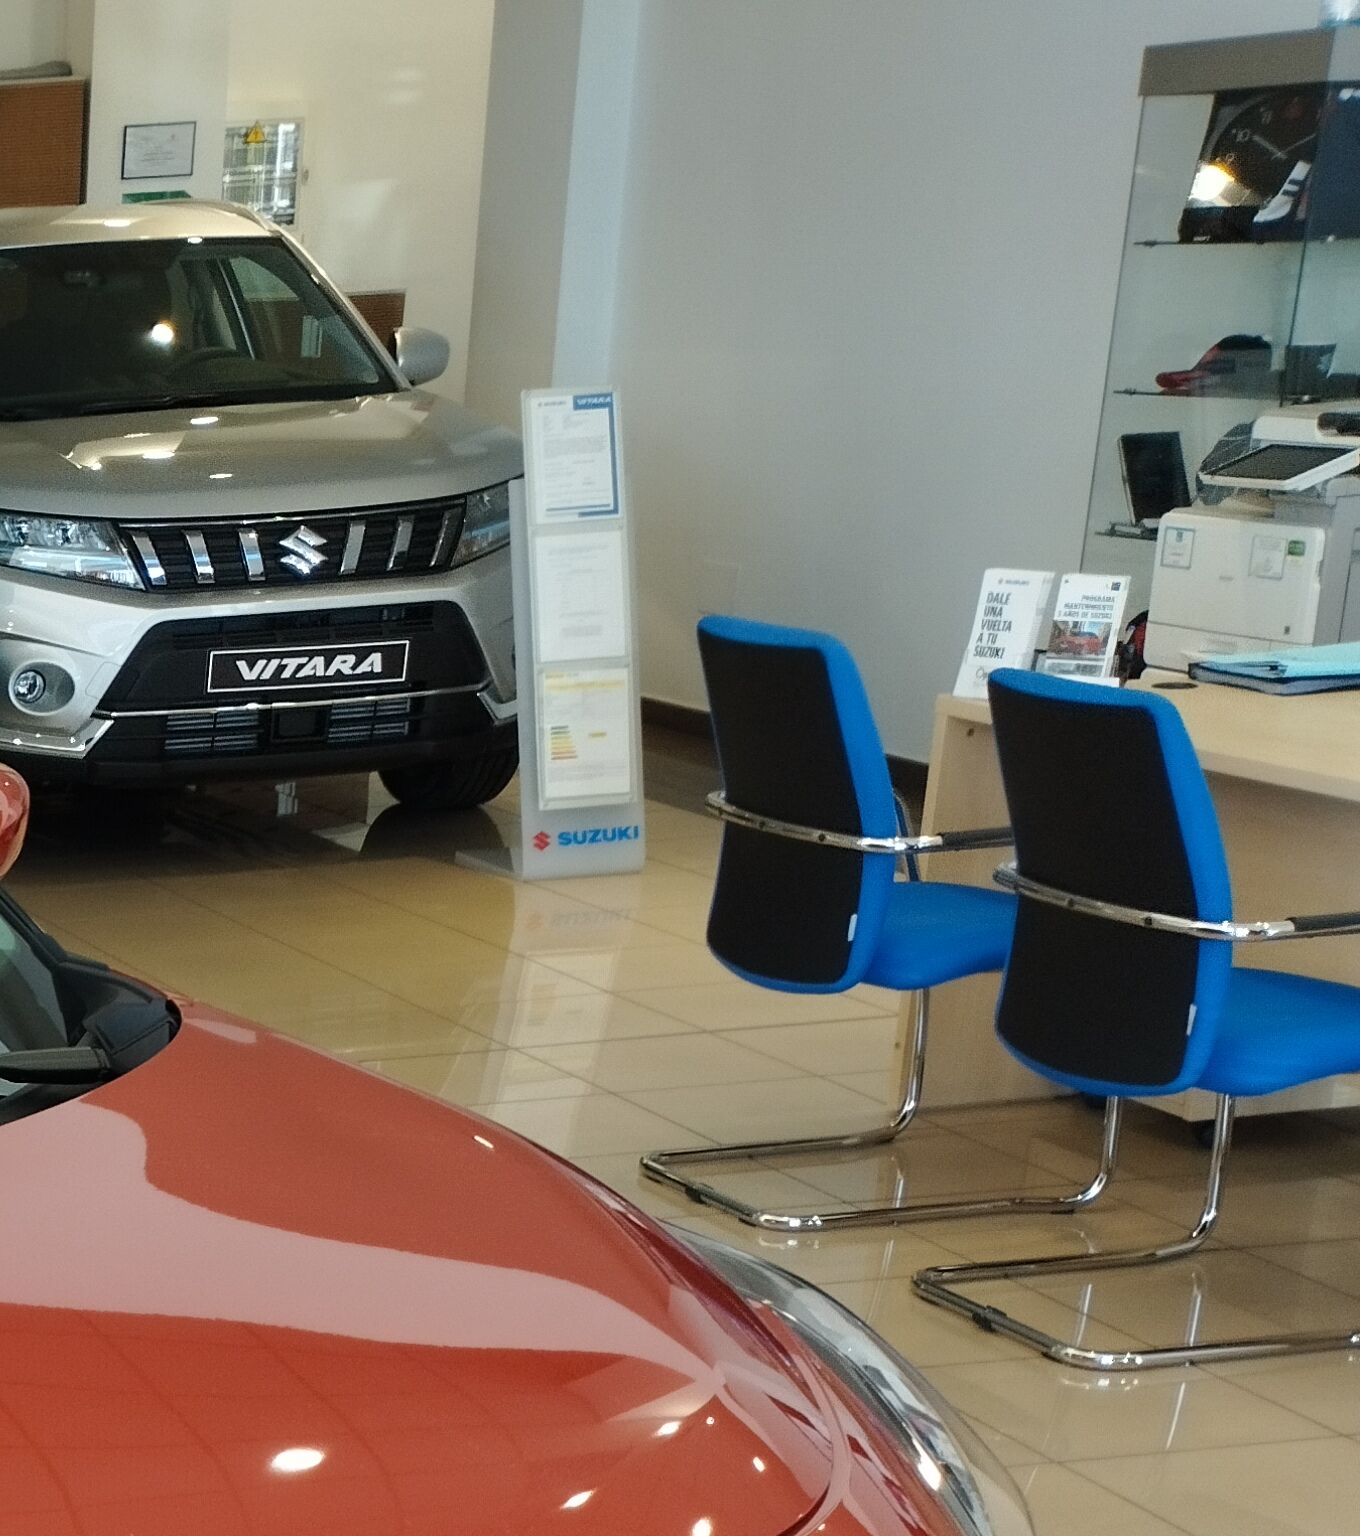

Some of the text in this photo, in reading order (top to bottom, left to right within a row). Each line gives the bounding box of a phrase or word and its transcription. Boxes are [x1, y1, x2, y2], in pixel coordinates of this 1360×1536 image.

[985, 592, 1012, 606] DALE
[984, 605, 1004, 618] UNA
[981, 619, 1013, 633] VUELTA
[976, 632, 999, 646] A TU
[973, 645, 1007, 660] SUZUKI
[234, 652, 383, 680] VITARA
[558, 825, 639, 847] SUZUKI
